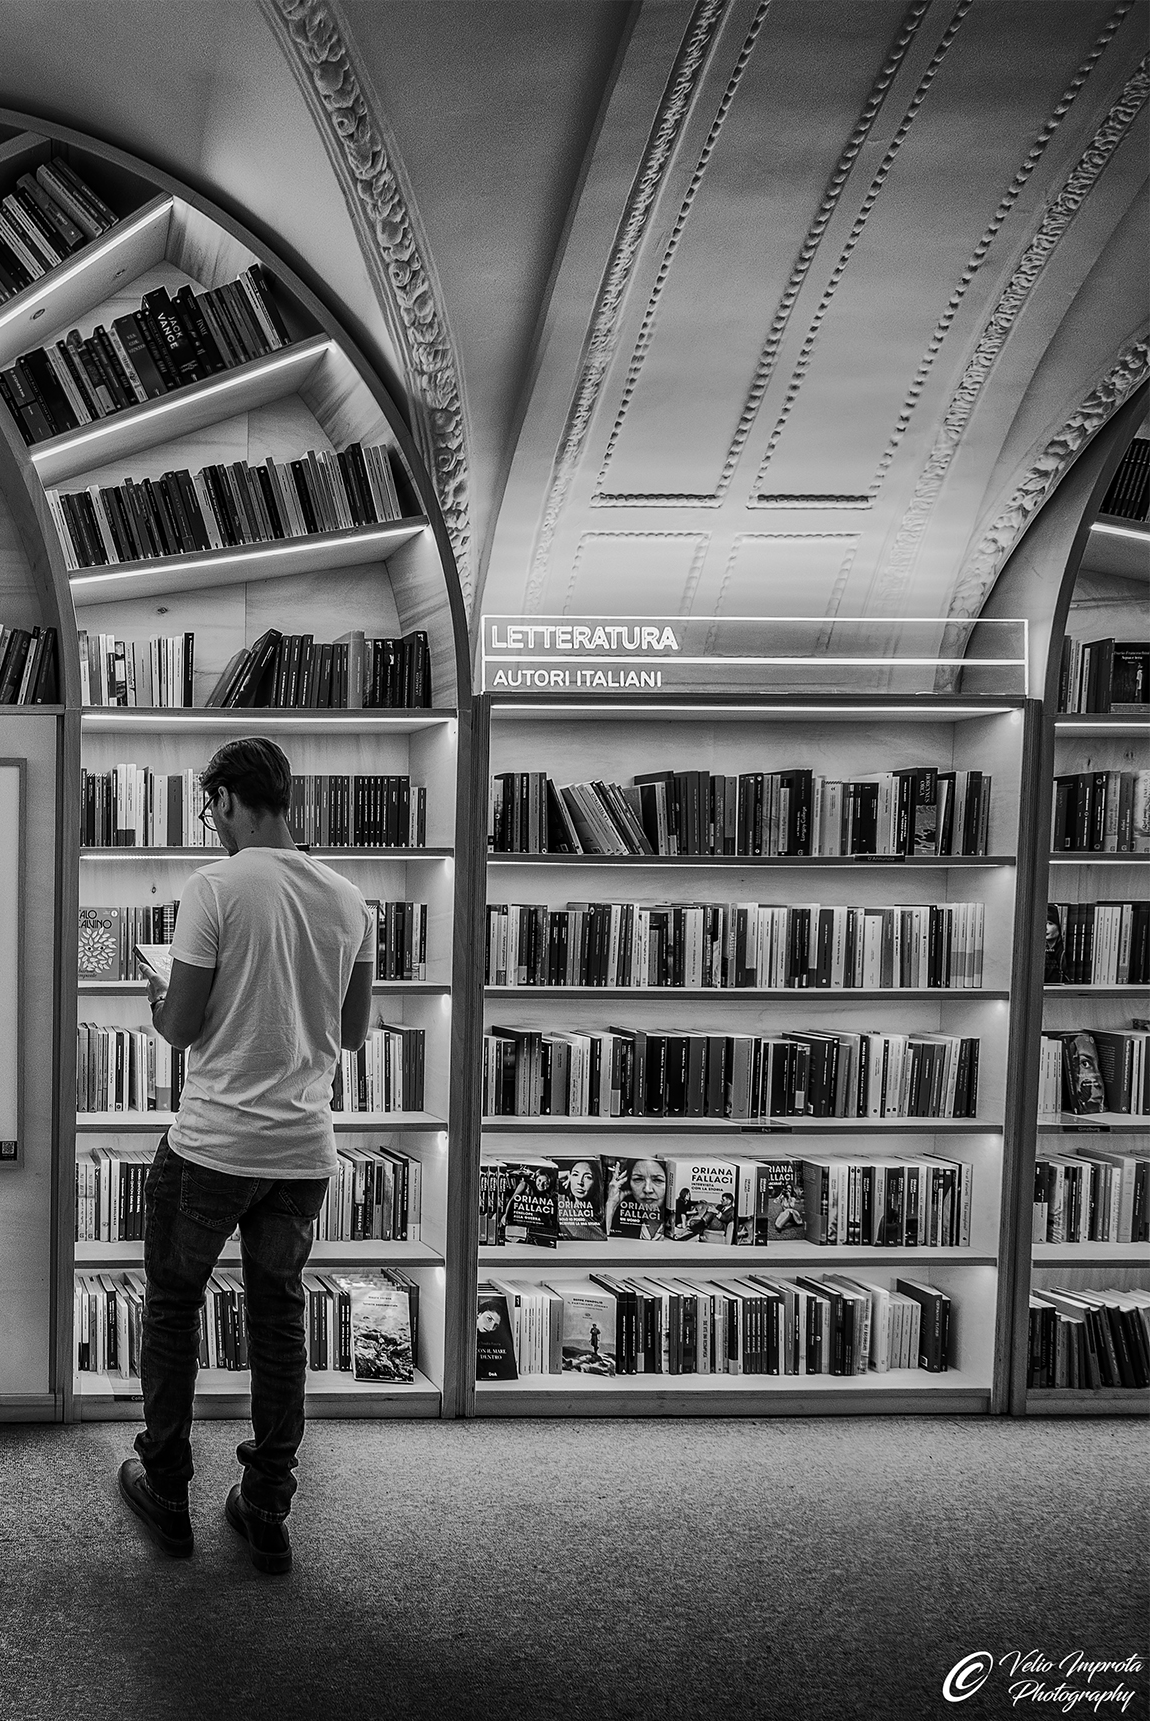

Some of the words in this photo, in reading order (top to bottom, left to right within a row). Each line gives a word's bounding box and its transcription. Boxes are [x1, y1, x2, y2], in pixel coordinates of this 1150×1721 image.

[155, 312, 179, 350] VANCE
[167, 314, 184, 338] JACK
[491, 624, 679, 651] LETTERATURA
[493, 669, 570, 687] AUTORI
[575, 669, 663, 688] ITALIANI
[691, 1166, 733, 1177] ORIANA
[768, 1165, 793, 1173] RIANA
[691, 1174, 733, 1185] FALLACI
[514, 1194, 555, 1206] ORIANA
[558, 1201, 593, 1210] ORIANA
[620, 1201, 661, 1210] ORIANA
[514, 1202, 555, 1215] FALLACI
[558, 1208, 594, 1217] FALLACI
[620, 1208, 661, 1221] FALLACI
